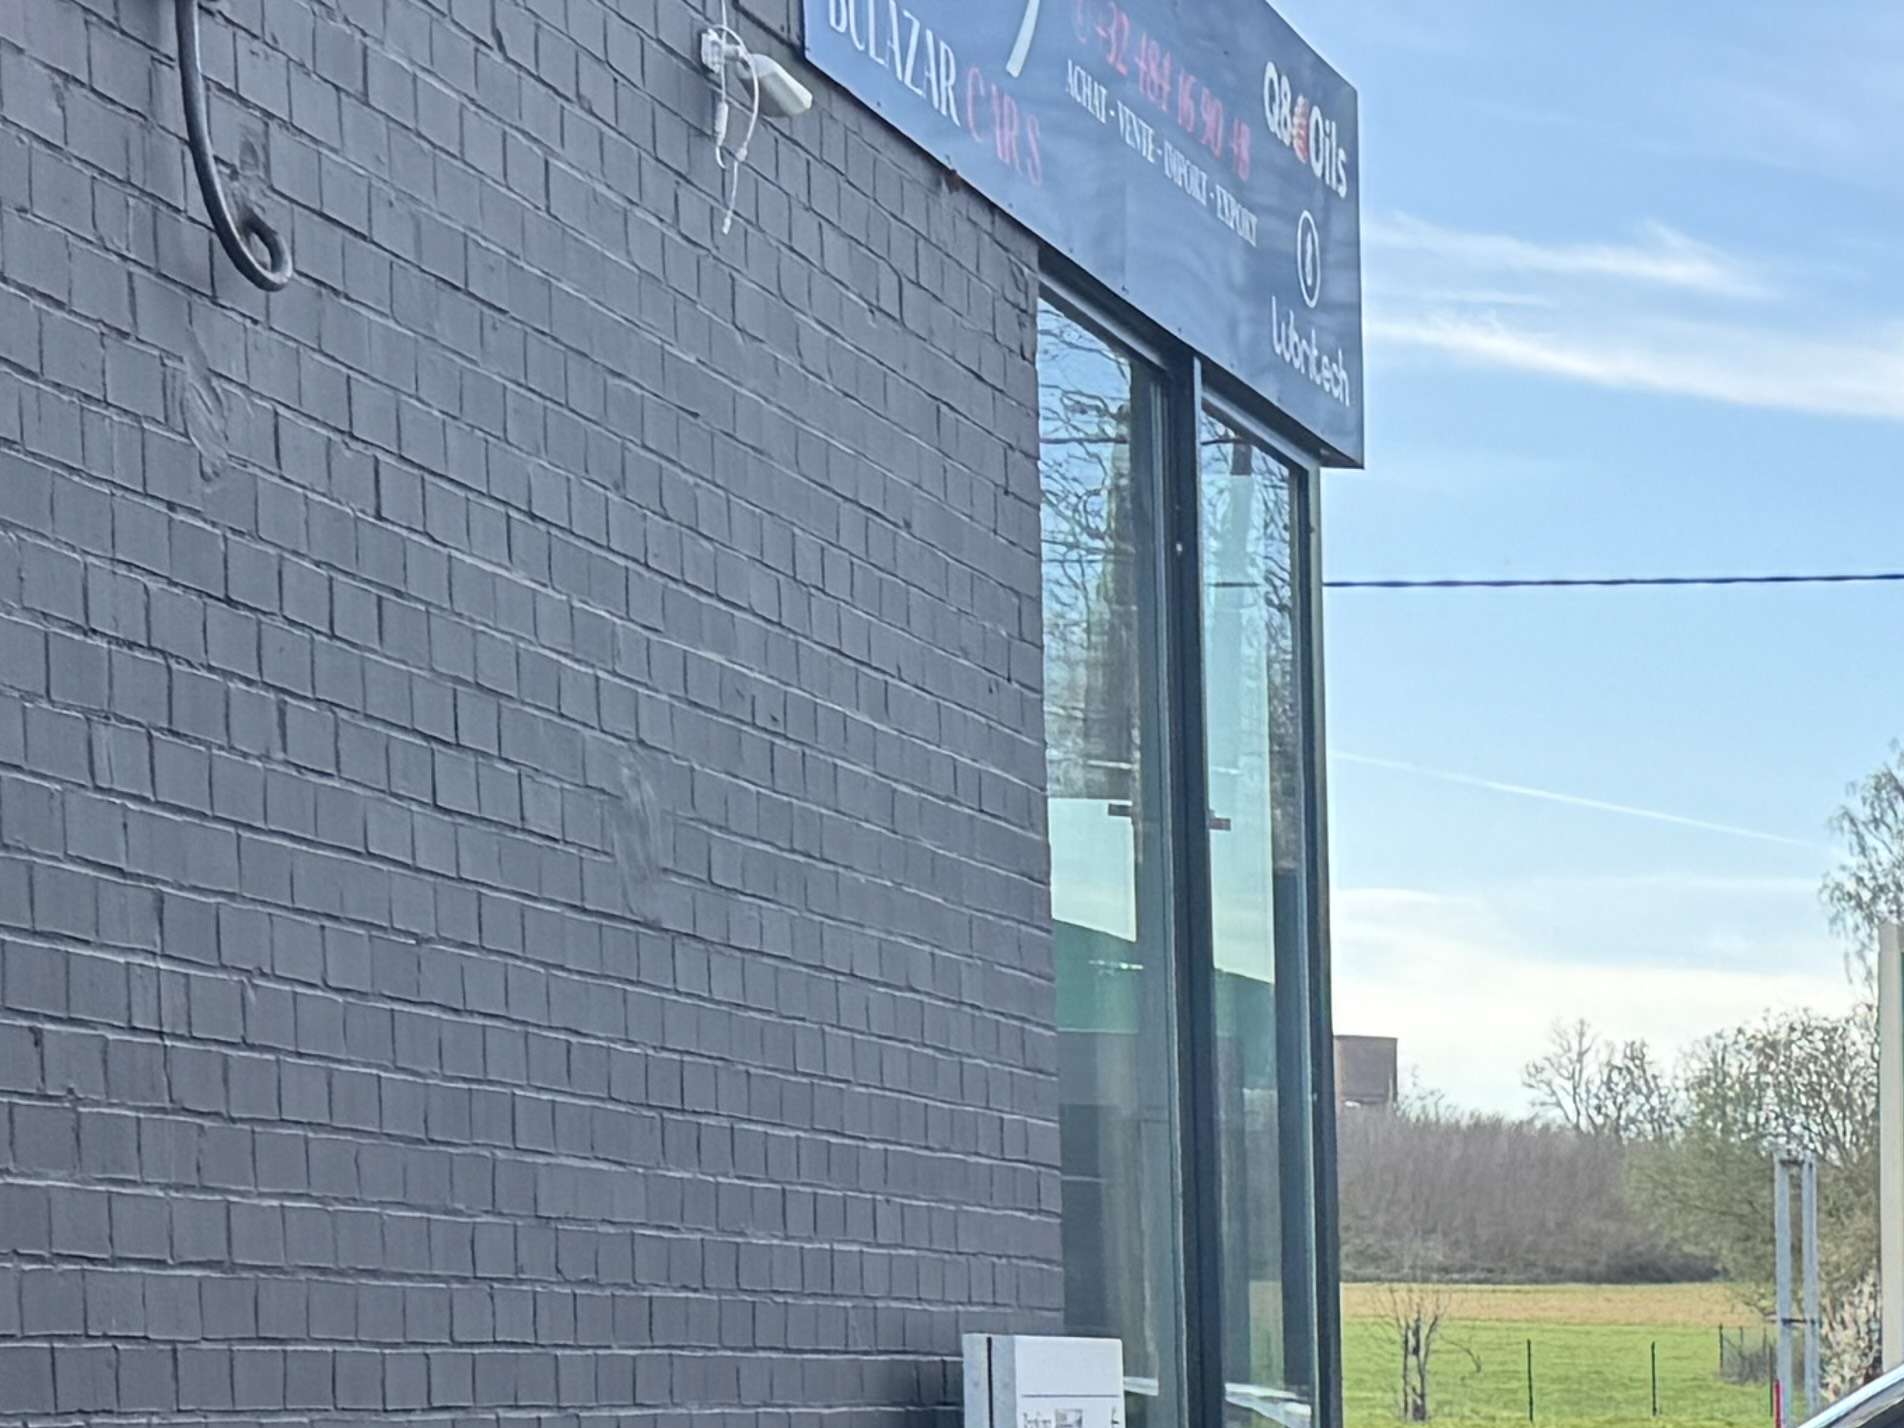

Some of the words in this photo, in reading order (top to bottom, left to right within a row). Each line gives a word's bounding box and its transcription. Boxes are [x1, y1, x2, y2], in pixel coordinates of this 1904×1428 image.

[966, 66, 1042, 187] CARS
[1066, 59, 1107, 124] ACHAT
[1117, 100, 1155, 164] VENTE
[1164, 140, 1208, 207] IMPORT
[1216, 185, 1258, 247] EXPORT
[1264, 61, 1292, 147] Q8
[1308, 105, 1347, 199] Oils
